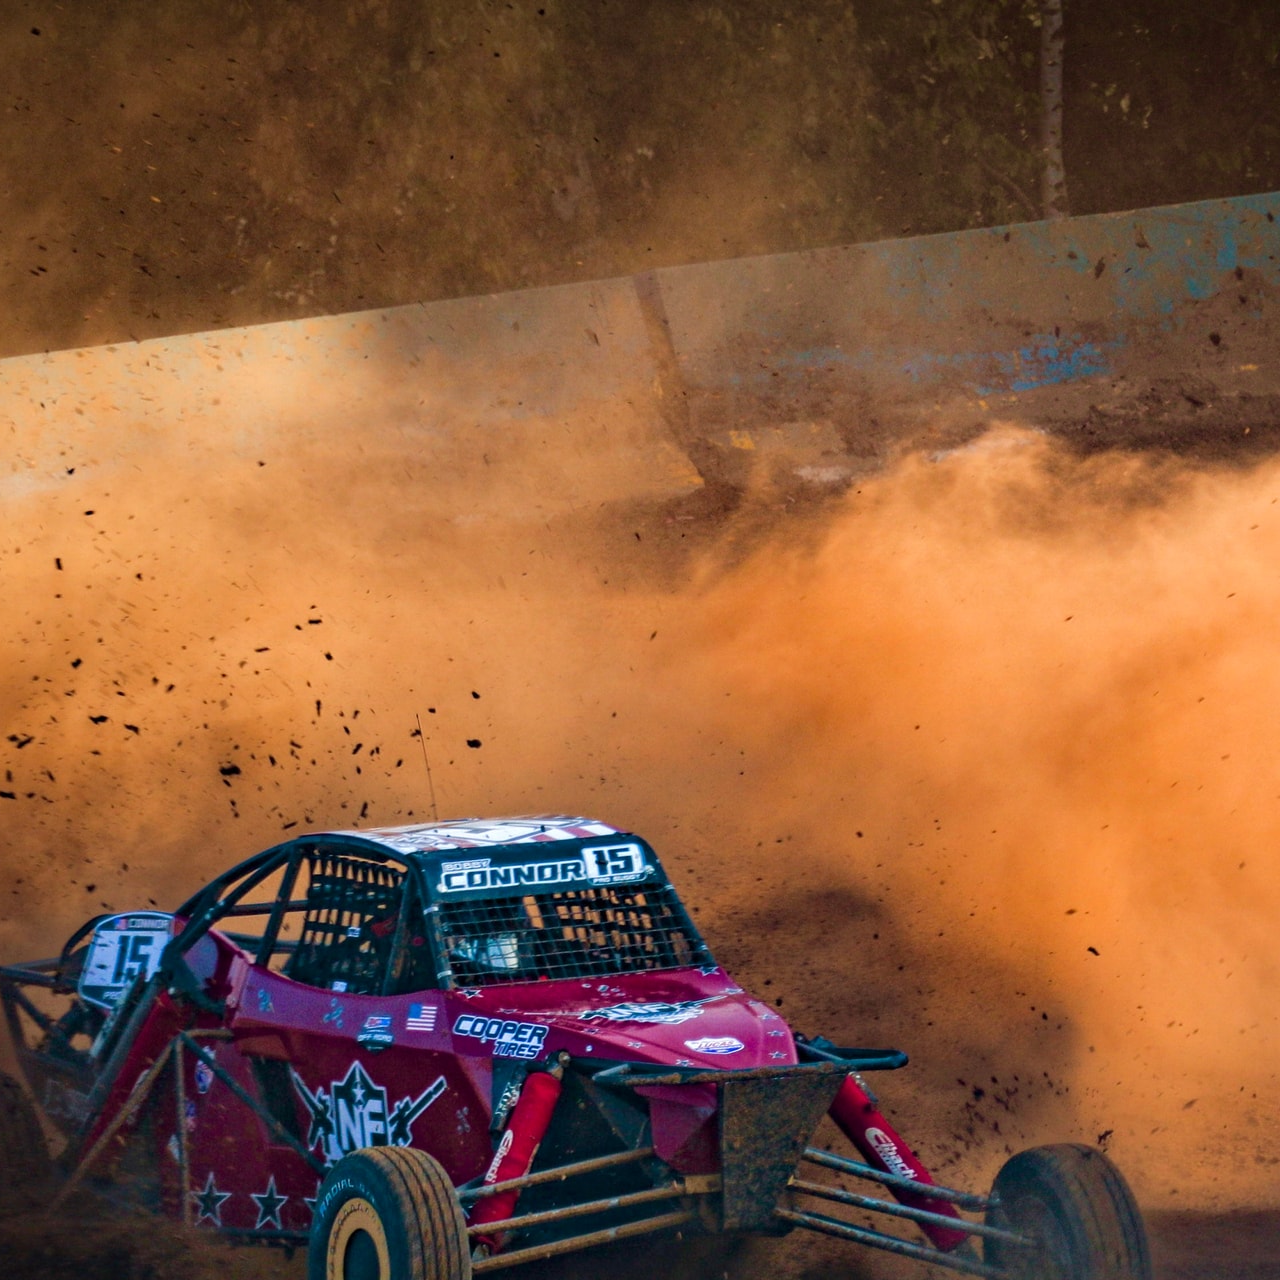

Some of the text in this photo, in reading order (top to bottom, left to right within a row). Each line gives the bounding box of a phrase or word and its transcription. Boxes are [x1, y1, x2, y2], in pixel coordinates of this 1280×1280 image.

[443, 861, 587, 890] CONNOR
[444, 860, 489, 871] BOBBY
[592, 847, 634, 876] 15
[592, 876, 611, 884] PRO
[111, 935, 154, 983] 15
[454, 1014, 548, 1044] COOPER
[493, 1041, 542, 1058] TIRES
[337, 1098, 385, 1151] NF
[320, 1178, 355, 1218] RADIAL
